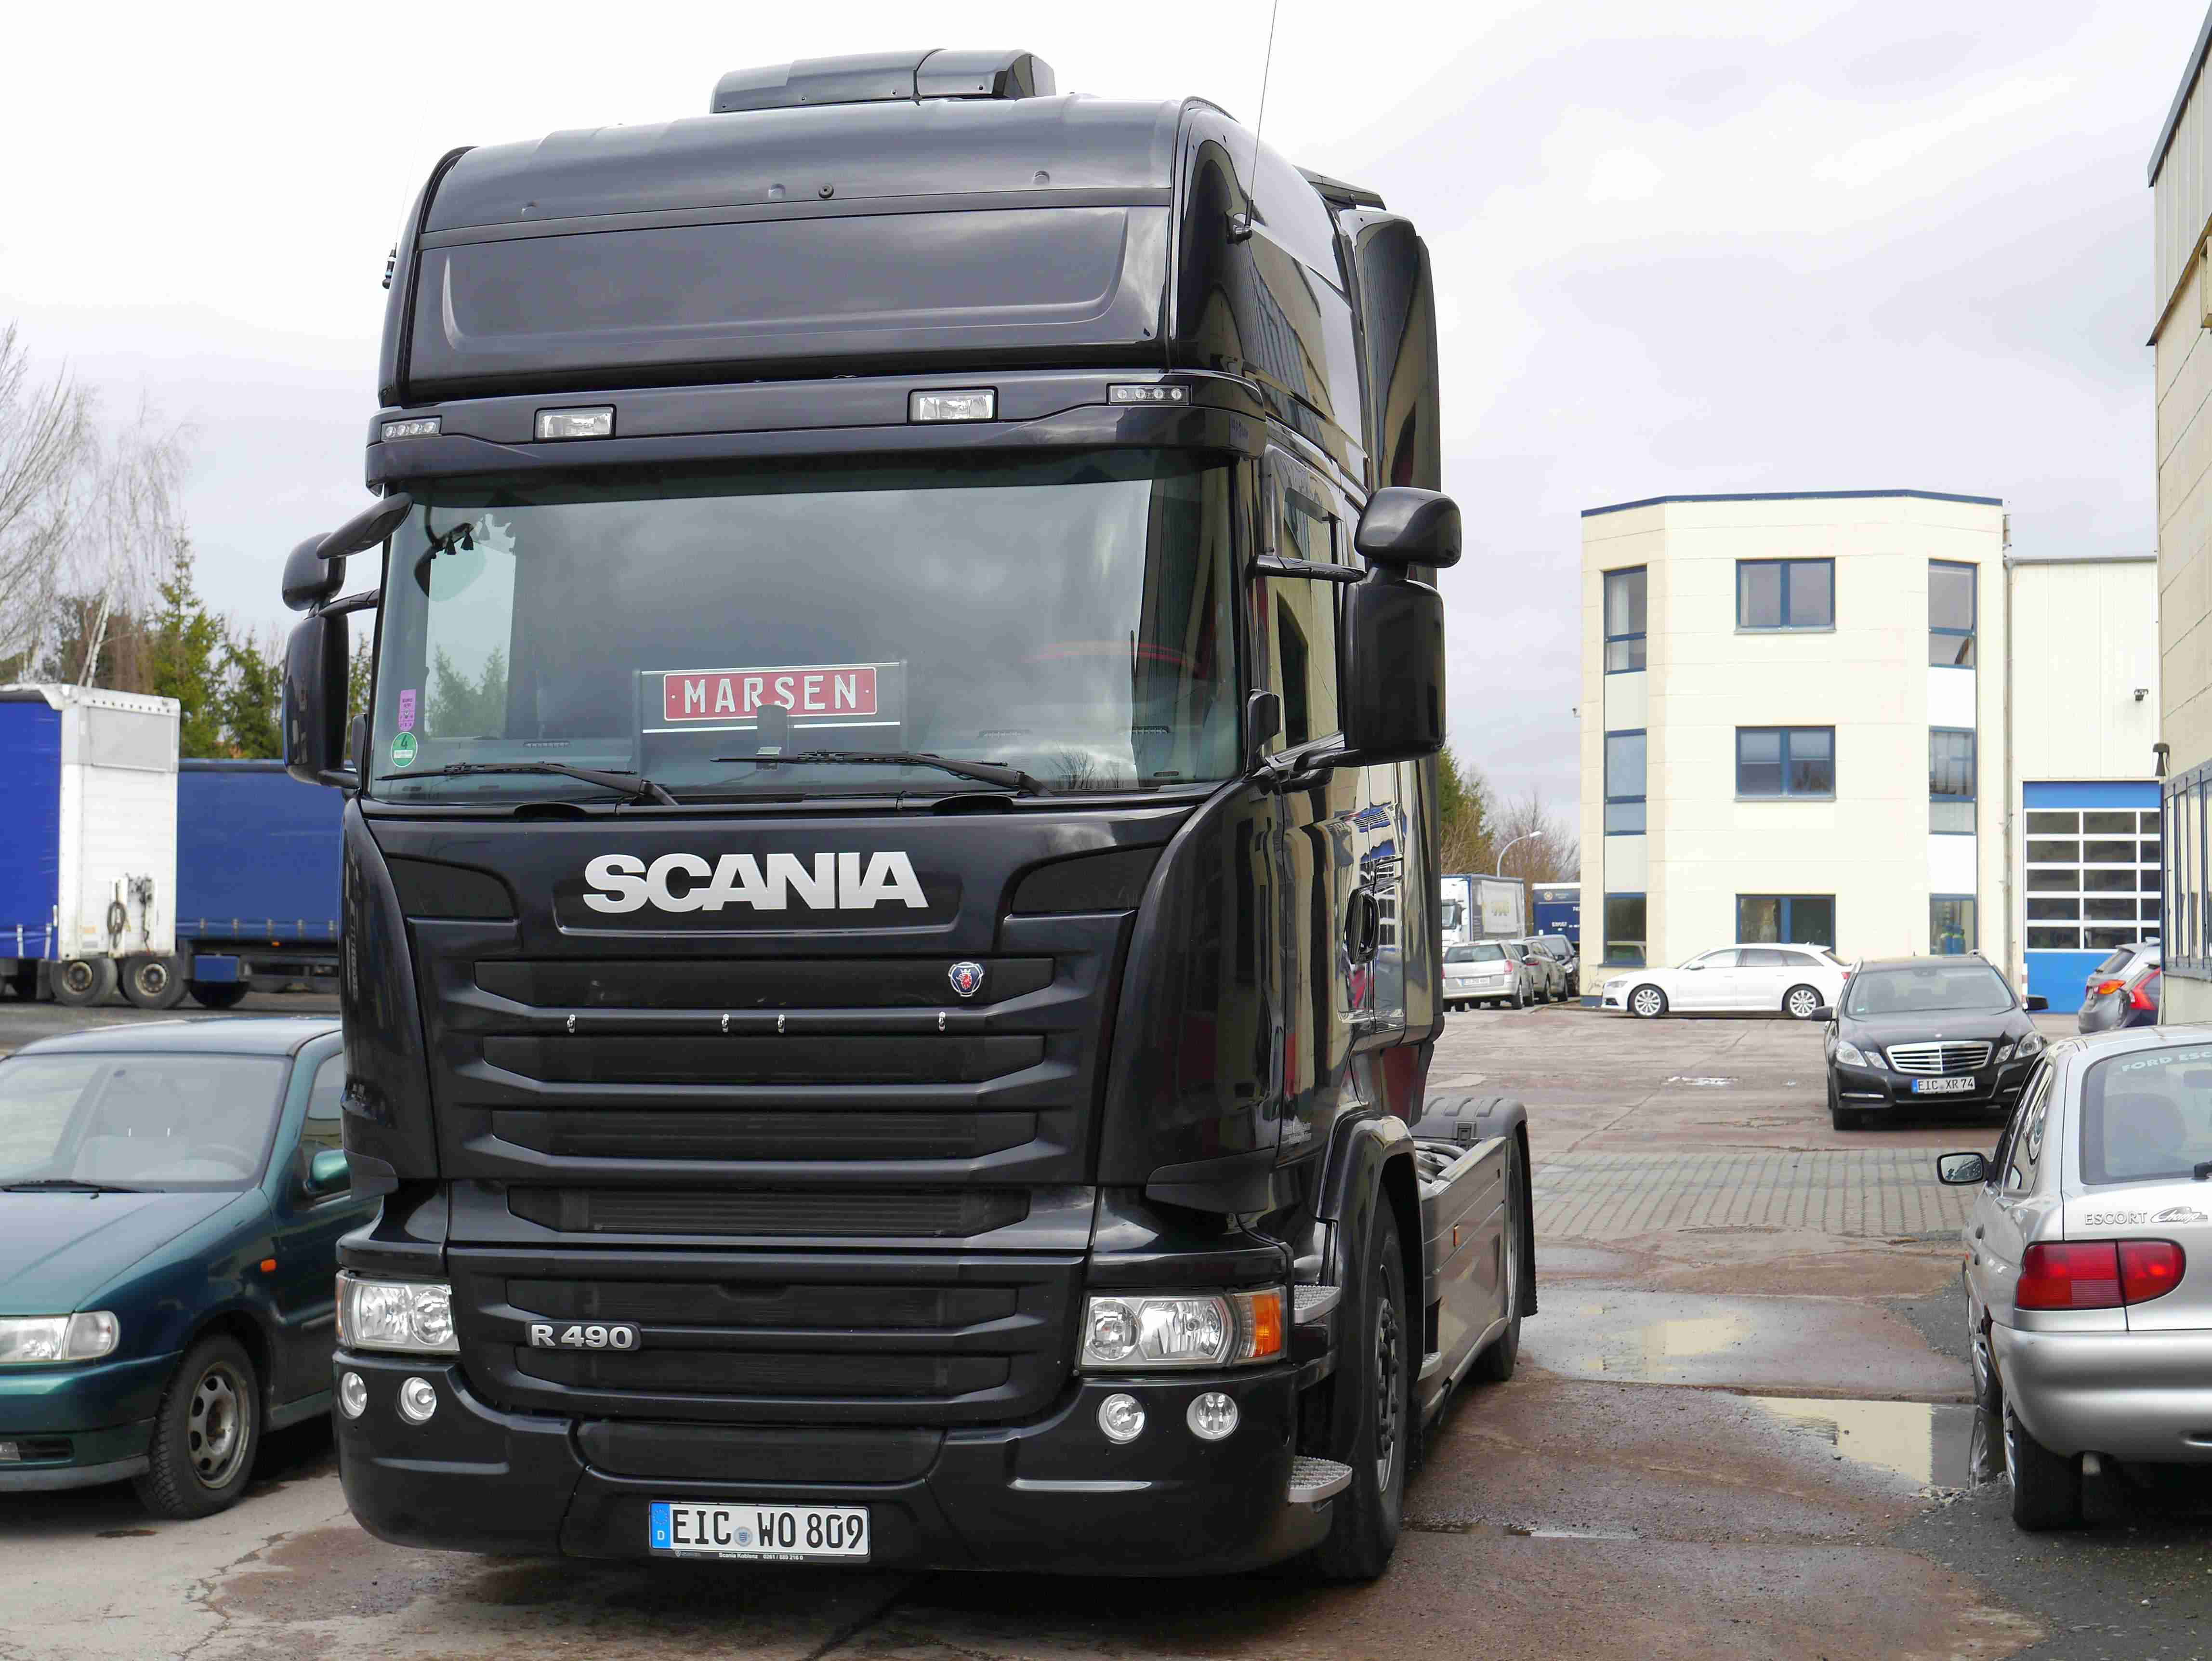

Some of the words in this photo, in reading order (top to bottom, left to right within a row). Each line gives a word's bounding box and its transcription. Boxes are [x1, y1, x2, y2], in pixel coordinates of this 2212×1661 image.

[684, 674, 856, 713] MARSEN
[400, 734, 408, 749] 4
[583, 851, 929, 913] SCANIA
[2122, 1056, 2172, 1072] FORD
[1918, 1081, 1938, 1091] EIC
[1946, 1079, 1959, 1090] XR
[1961, 1078, 1974, 1089] 74
[2085, 1212, 2147, 1226] ESCORT
[531, 1324, 555, 1346] R
[561, 1326, 633, 1349] 490
[657, 1530, 665, 1540] D
[673, 1509, 731, 1545] EIC
[757, 1512, 796, 1548] WO
[806, 1513, 864, 1549] 809
